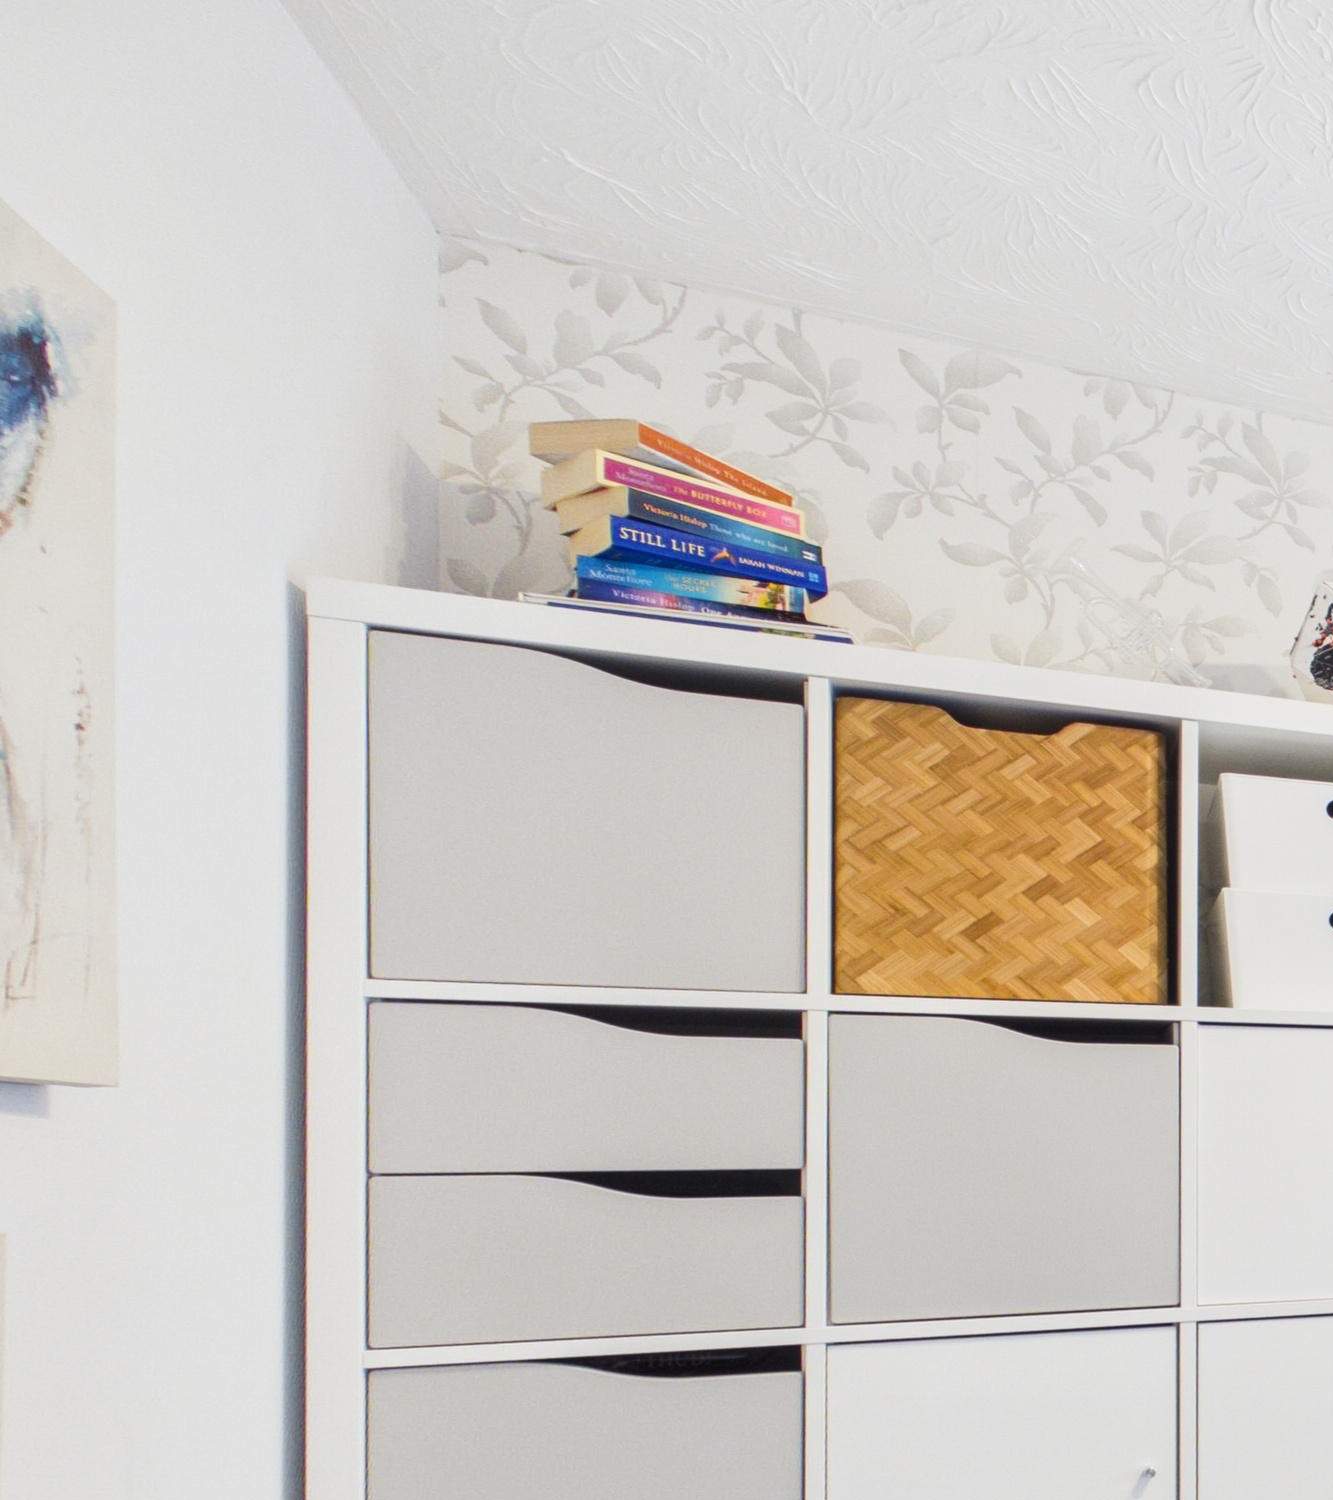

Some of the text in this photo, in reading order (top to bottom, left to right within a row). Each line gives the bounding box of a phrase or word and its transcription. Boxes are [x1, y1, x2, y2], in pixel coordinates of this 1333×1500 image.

[619, 527, 706, 557] STILL LIFE
[611, 588, 657, 605] Victoria
